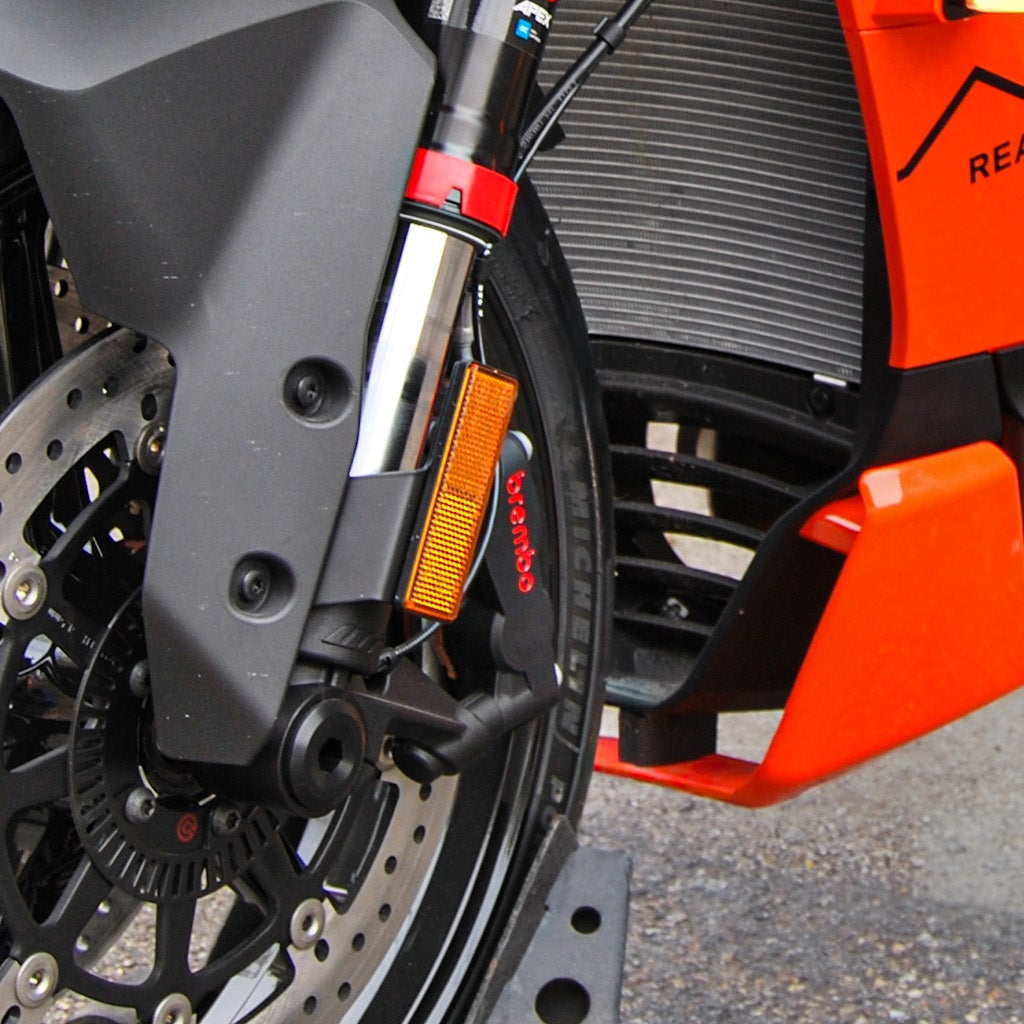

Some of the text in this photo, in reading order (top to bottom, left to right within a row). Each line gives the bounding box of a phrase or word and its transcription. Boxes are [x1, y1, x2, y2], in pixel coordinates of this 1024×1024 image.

[512, 0, 552, 29] APEX
[506, 469, 536, 593] brembo
[561, 480, 592, 736] MICHELIN
